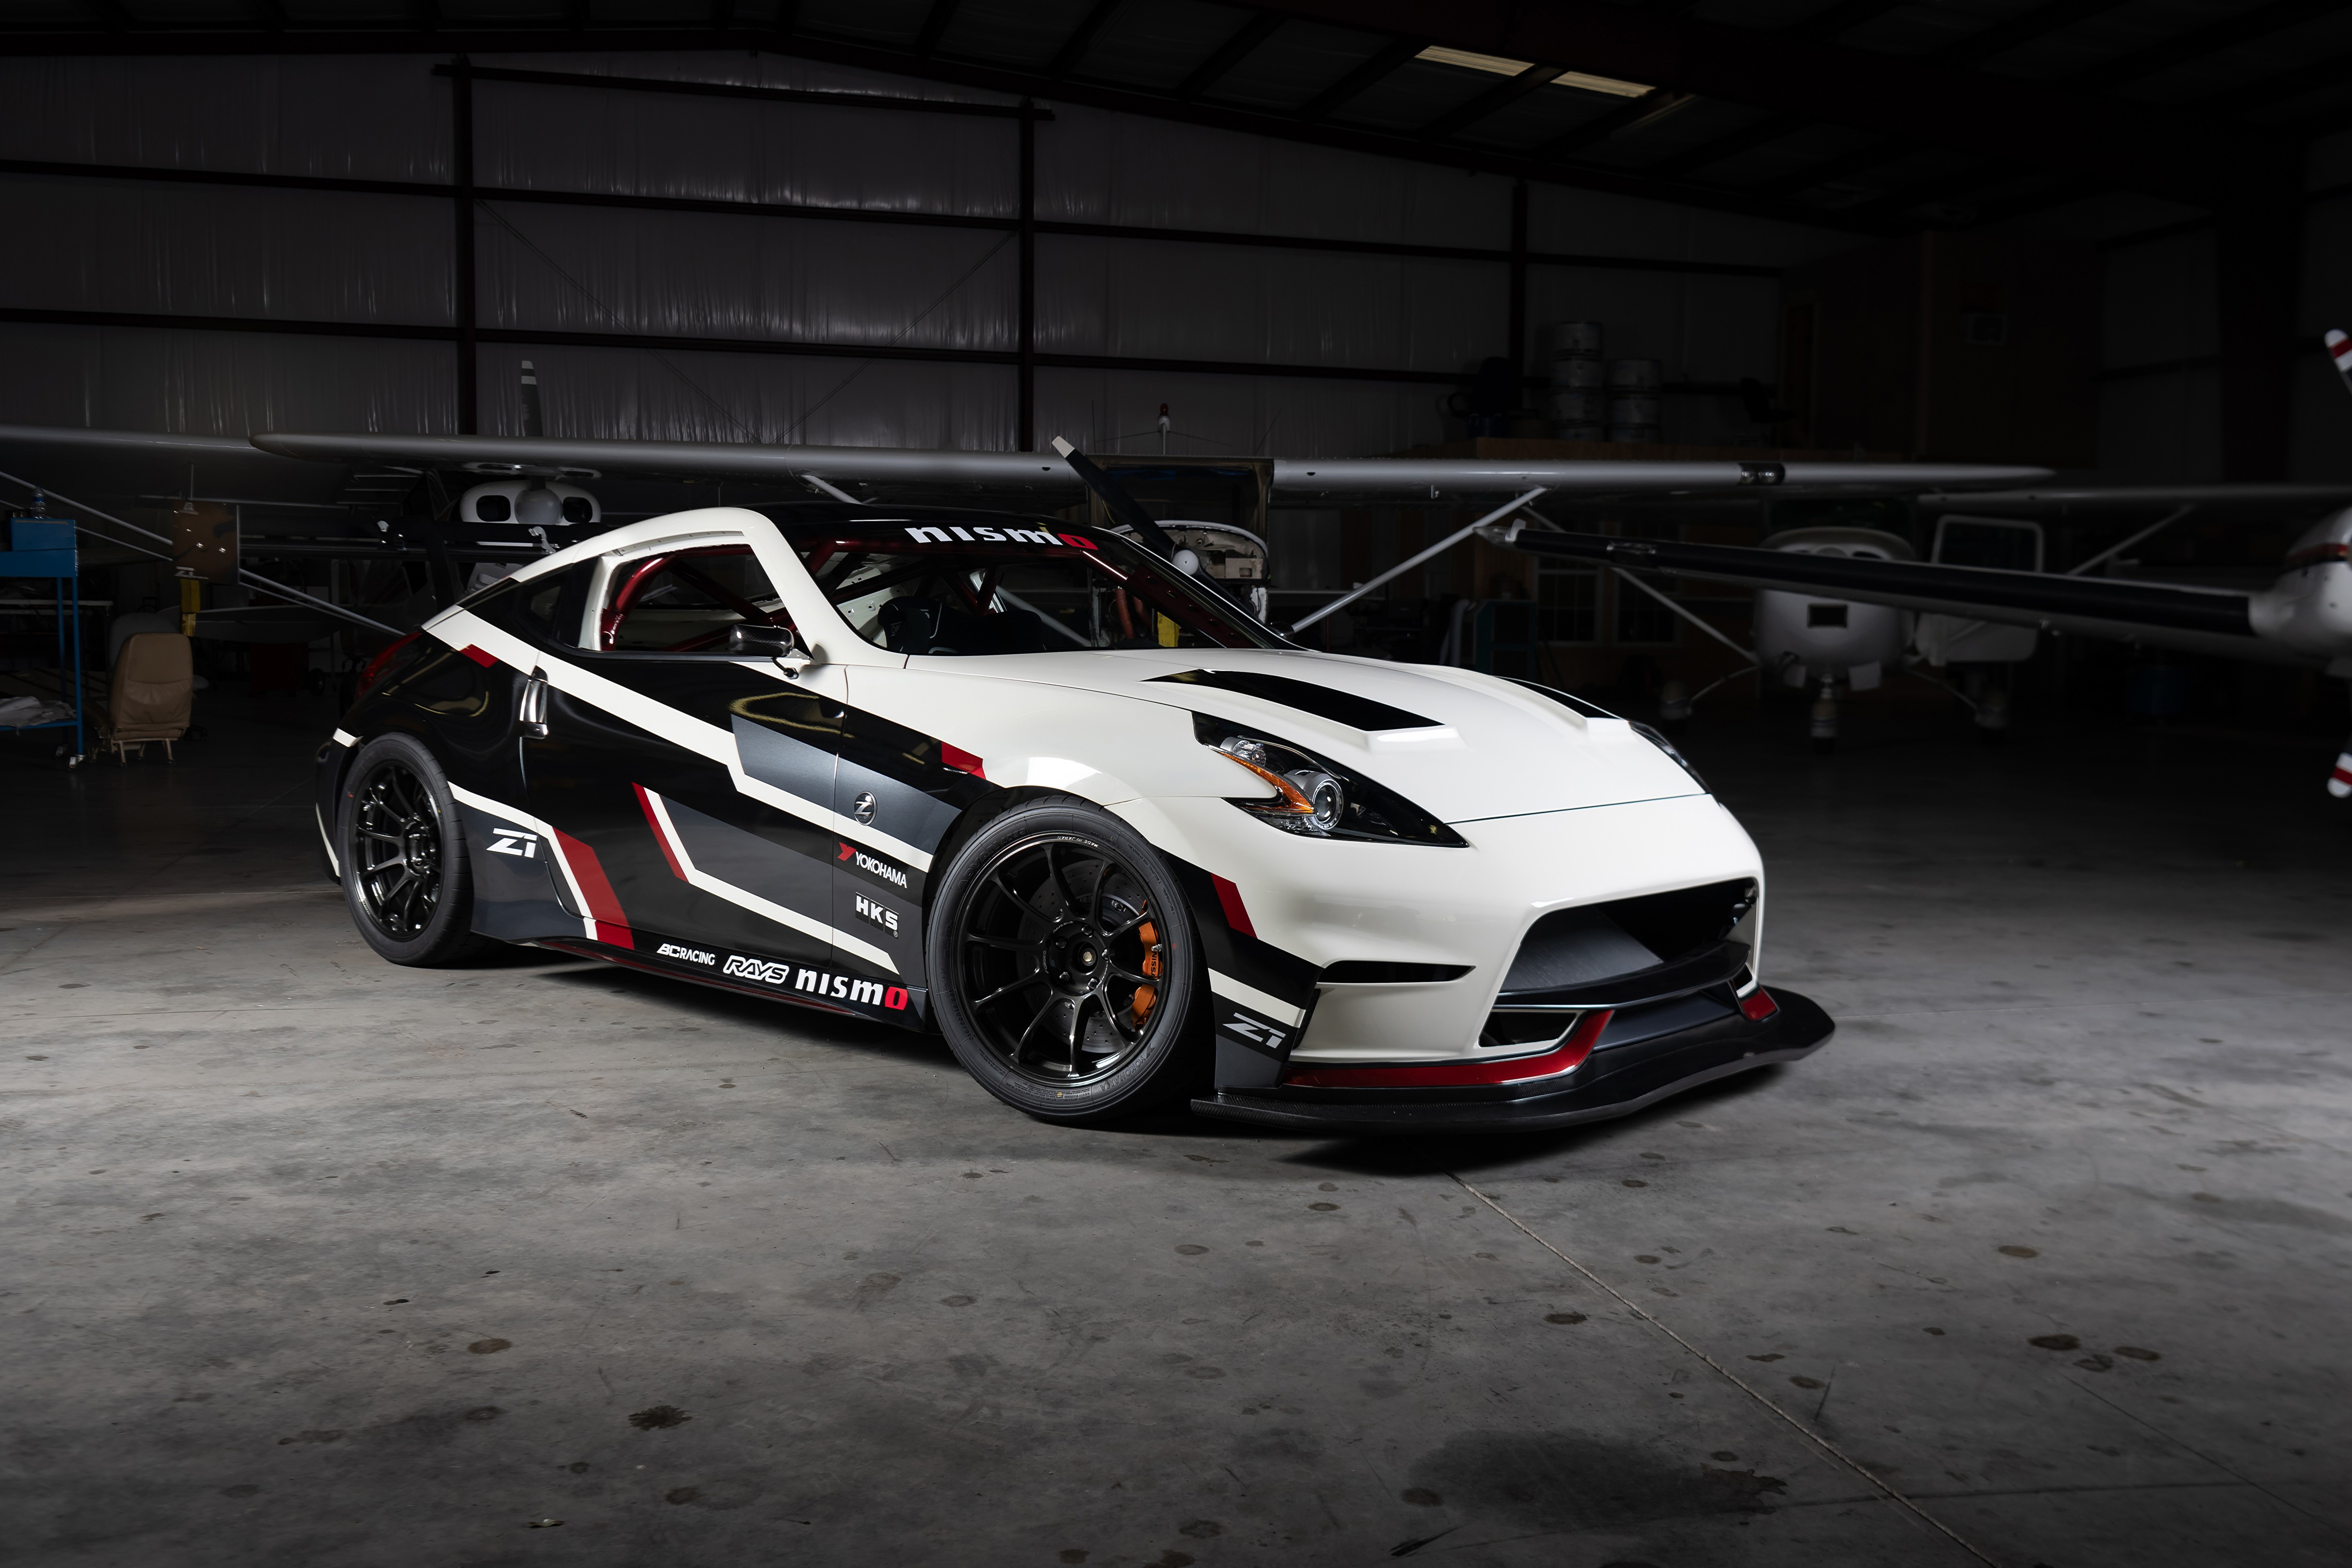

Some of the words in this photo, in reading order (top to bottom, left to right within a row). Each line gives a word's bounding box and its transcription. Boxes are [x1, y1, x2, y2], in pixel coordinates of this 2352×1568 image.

[855, 851, 907, 888] YOKOHAMA
[959, 841, 1001, 891] ADVAN
[856, 895, 898, 931] HKS
[723, 955, 789, 984] RAYS
[1100, 1055, 1145, 1091] YOKOHAMA
